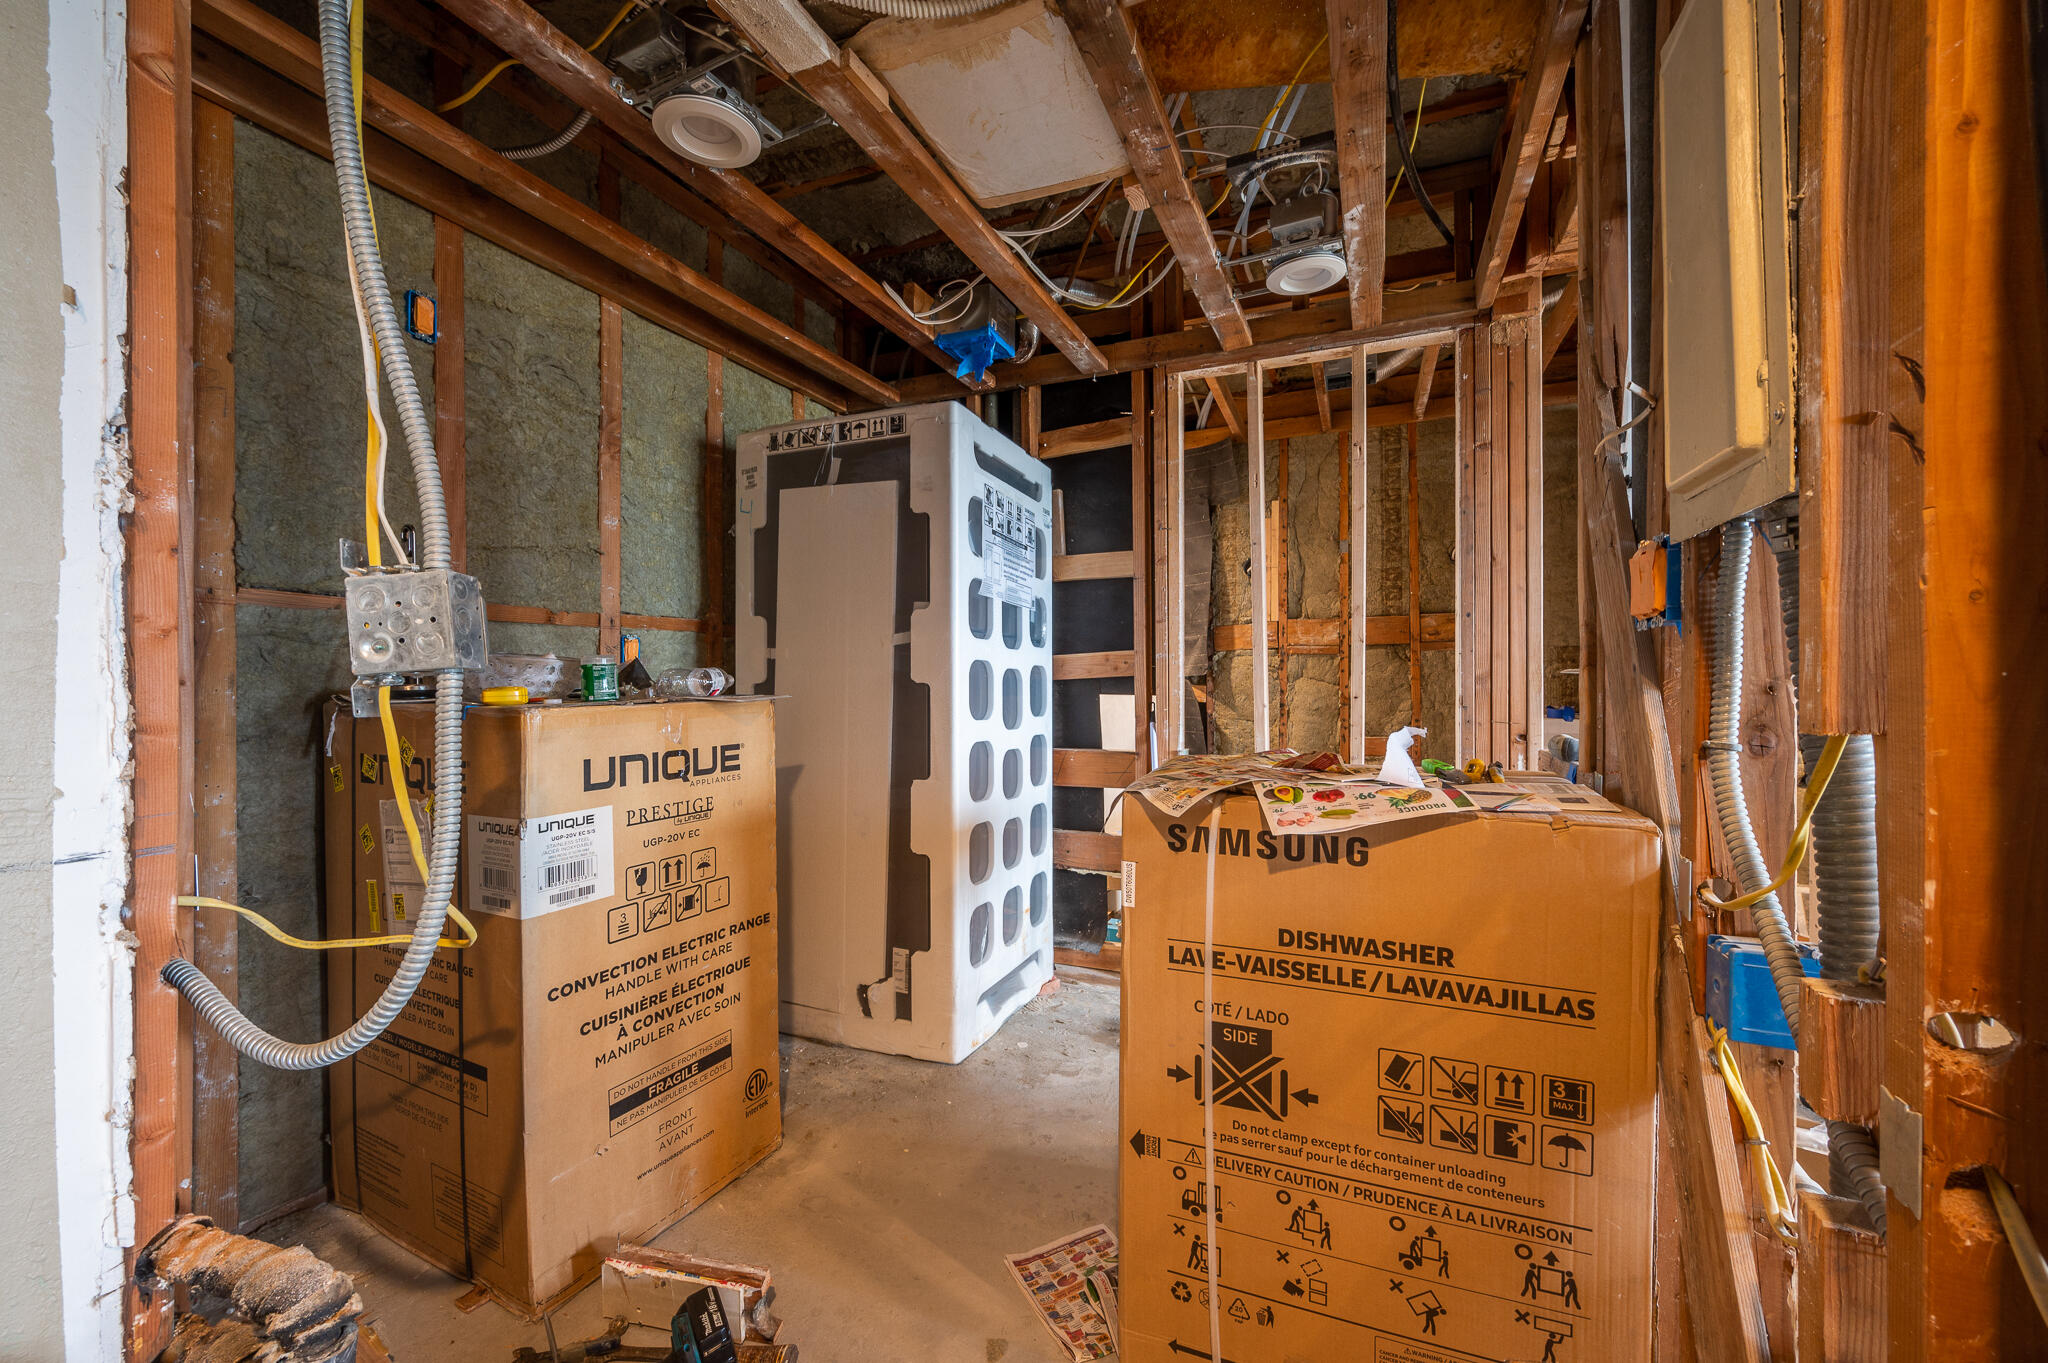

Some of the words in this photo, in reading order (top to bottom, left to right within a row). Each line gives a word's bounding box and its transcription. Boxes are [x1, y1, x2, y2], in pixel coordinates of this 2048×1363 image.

[583, 743, 741, 792] UNIQUE
[689, 773, 742, 788] APPLIANCES
[478, 821, 514, 836] UNIQUE
[538, 814, 595, 834] UNIQUE
[626, 796, 714, 826] PRESTIGE
[551, 832, 577, 842] UGP-20V
[643, 831, 686, 848] UGP-20V
[688, 828, 700, 839] EC
[1167, 823, 1369, 867] SAMSUNG
[620, 912, 627, 924] 3
[547, 951, 658, 1002] CONVECTION
[662, 928, 725, 961] ELECTRIC
[729, 912, 771, 936] RANGE
[1278, 928, 1456, 969] DISHWASHER
[429, 970, 448, 984] CARE
[605, 968, 662, 1000] HANDLE
[665, 954, 698, 976] WITH
[702, 941, 733, 961] CARE
[579, 989, 668, 1036] CUISINIÈRE
[671, 956, 751, 999] ÉLECTRIQUE
[617, 1023, 628, 1041] À
[632, 983, 724, 1033] CONVECTION
[1194, 999, 1232, 1018] CTÉ
[1246, 1007, 1289, 1026] LADO
[1386, 972, 1596, 1022] LAVAVAJILLAS
[418, 1017, 436, 1030] AVEC
[438, 1023, 455, 1037] SOIN
[595, 1023, 675, 1068] MANIPULER
[678, 1006, 711, 1031] AVEC
[714, 992, 741, 1013] SOIN
[1223, 1027, 1258, 1046] SIDE
[613, 1087, 626, 1100] DO
[627, 1077, 645, 1093] NOT
[646, 1061, 676, 1082] HANDLE
[677, 1052, 698, 1068] FROM
[699, 1043, 713, 1058] THIS
[714, 1035, 729, 1048] SIDE
[648, 1062, 699, 1098] FRAGILE
[616, 1115, 628, 1128] NE
[629, 1107, 645, 1122] PAS
[646, 1086, 687, 1113] MANIPULER
[688, 1078, 699, 1090] DE
[699, 1073, 709, 1083] CE
[709, 1062, 728, 1077] CÔTÉ
[1552, 1082, 1566, 1098] 3
[1552, 1101, 1574, 1113] MAX
[658, 1107, 694, 1134] FRONT
[658, 1123, 694, 1152] AVANT
[636, 1129, 715, 1181] www.uniqueappliances.com
[1219, 1132, 1240, 1147] pas
[1241, 1136, 1277, 1151] serrer
[1278, 1141, 1304, 1157] sauf
[1306, 1150, 1334, 1167] pour
[1337, 1154, 1347, 1168] le
[1350, 1156, 1444, 1187] déchargement
[1446, 1178, 1464, 1192] de
[1466, 1184, 1546, 1209] conteneurs
[1232, 1119, 1248, 1132] Do
[1250, 1124, 1270, 1137] not
[1272, 1128, 1308, 1146] clamp
[1311, 1138, 1351, 1155] except
[1353, 1144, 1372, 1157] for
[1374, 1149, 1436, 1170] container
[1438, 1162, 1507, 1187] unloading
[1213, 1155, 1271, 1179] ELIVERY
[1274, 1168, 1339, 1195] CAUTION
[1353, 1186, 1438, 1217] PRUDENCE
[1441, 1203, 1453, 1220] À
[1456, 1208, 1477, 1226] LA
[1480, 1213, 1573, 1246] LIVRAISON
